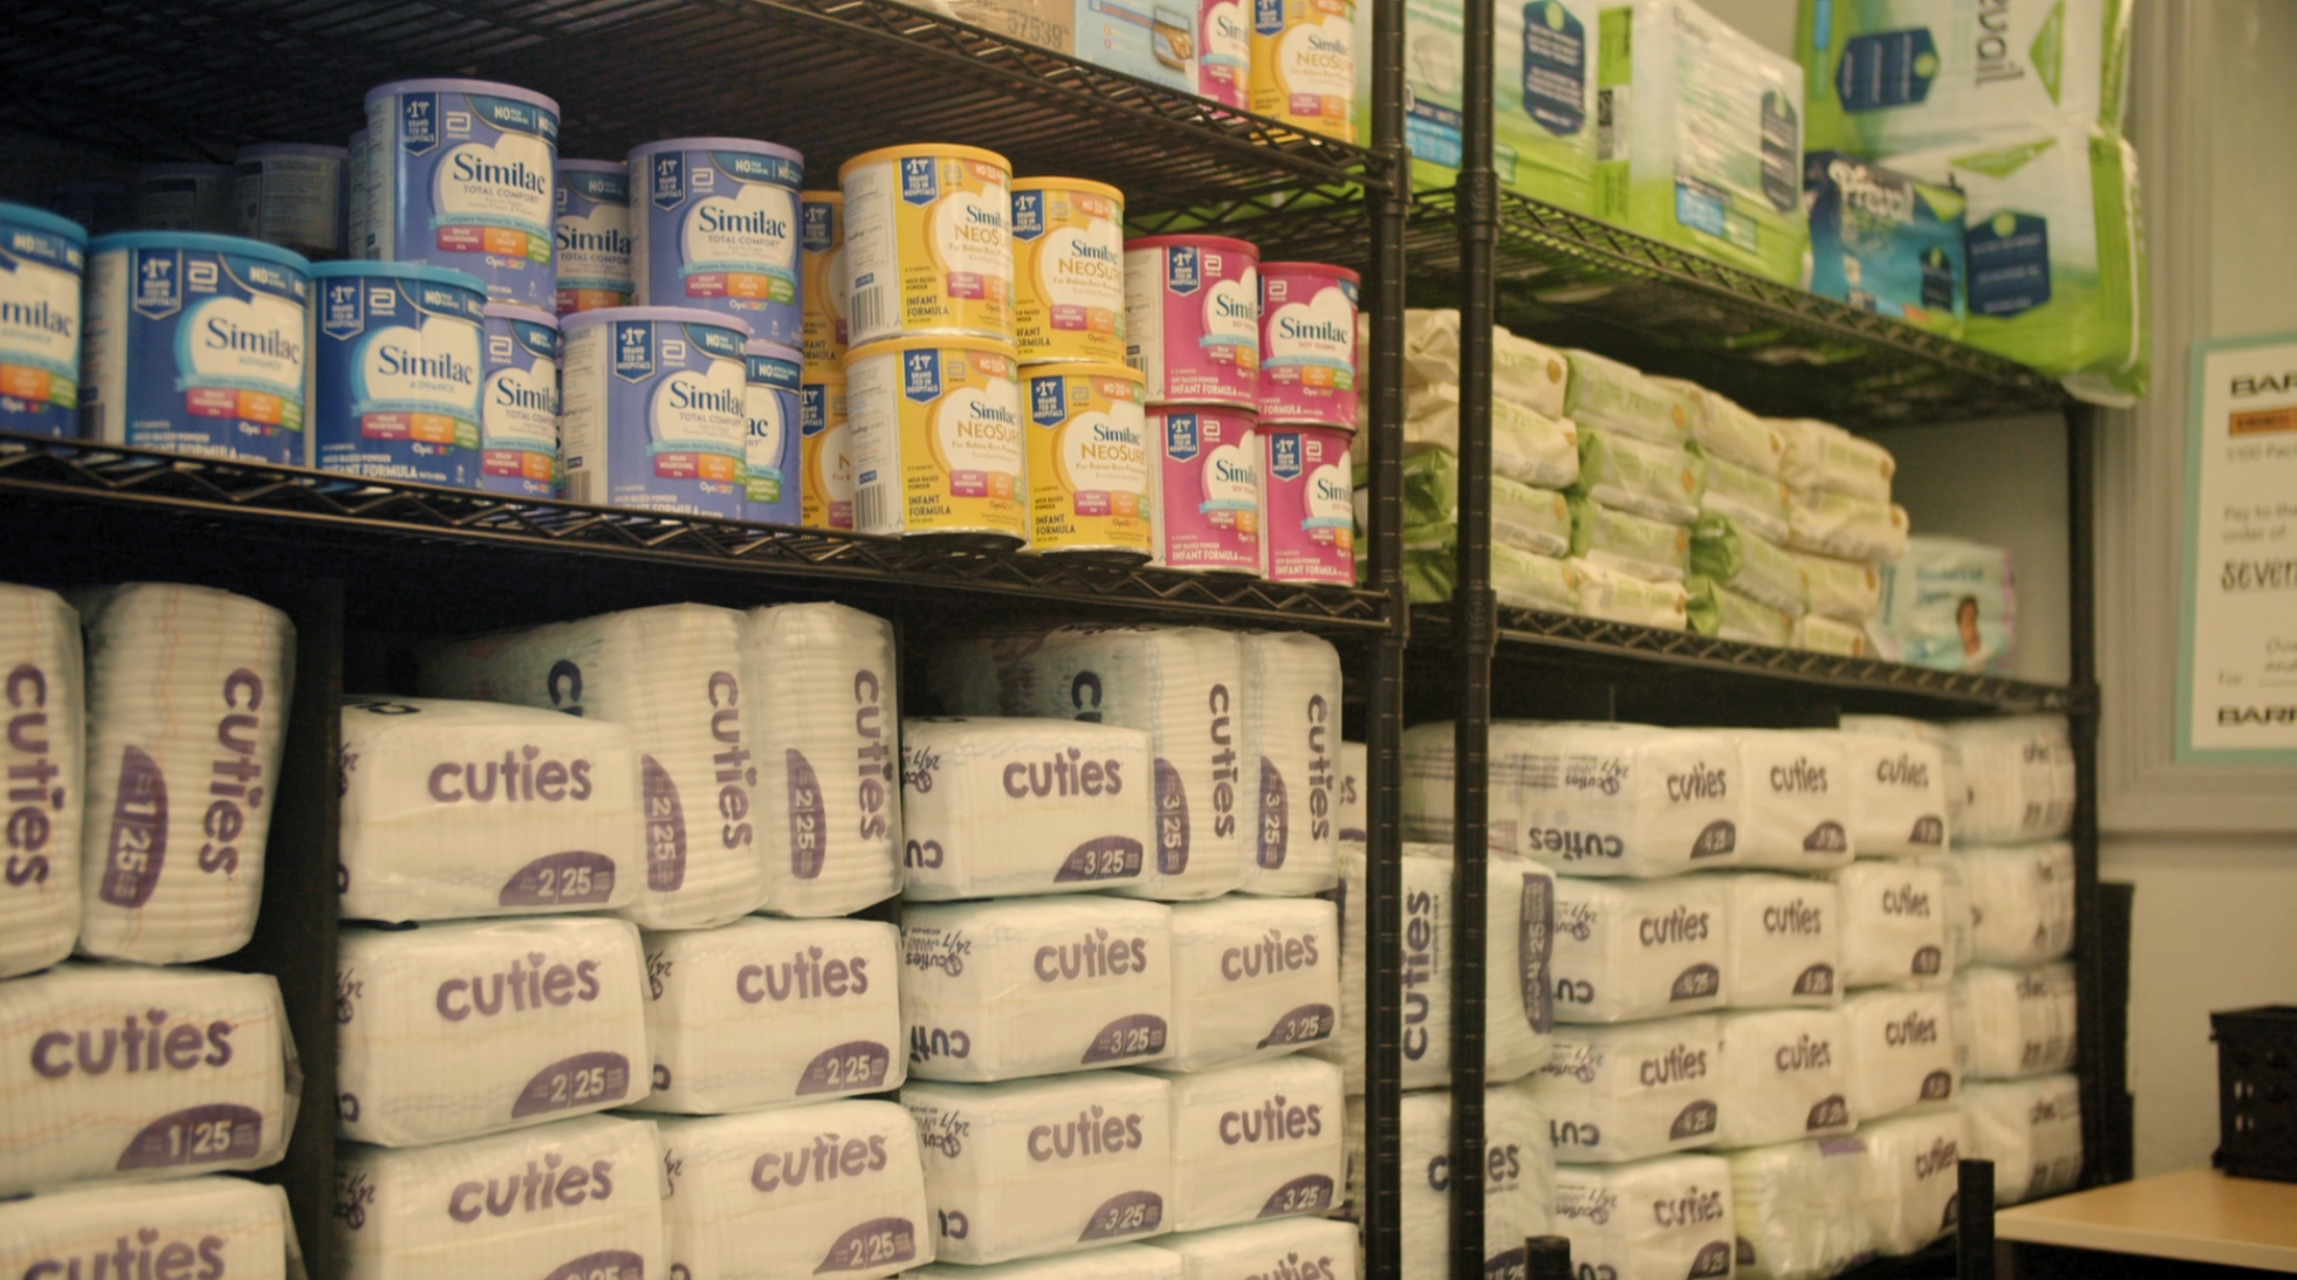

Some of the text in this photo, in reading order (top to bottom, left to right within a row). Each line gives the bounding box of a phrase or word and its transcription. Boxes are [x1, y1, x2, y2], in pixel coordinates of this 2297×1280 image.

[1006, 9, 1064, 50] 57539
[408, 118, 429, 128] BRAND
[494, 105, 510, 120] NO
[404, 134, 435, 144] HOSPITALS
[453, 152, 546, 195] Similac
[735, 160, 751, 173] NO
[908, 174, 929, 183] BRAND
[463, 184, 539, 203] TOTAL COMFORT
[904, 187, 935, 197] HOSPITALS
[699, 205, 787, 239] Similac
[556, 223, 631, 257] Simila
[708, 235, 779, 248] TOTAL COMFORT
[560, 252, 587, 262] TOTAL
[425, 290, 442, 304] NO
[906, 295, 938, 306] INFANT
[907, 305, 949, 317] FORMULA
[1, 301, 73, 338] milac
[1279, 316, 1348, 344] Similac
[205, 316, 301, 365] Similac
[529, 330, 541, 343] NO
[622, 346, 645, 355] BRAND
[705, 334, 720, 348] NO
[378, 344, 473, 386] Similac
[617, 361, 651, 370] HOSPITALS
[623, 354, 644, 362] FED IN
[758, 363, 773, 377] NO
[410, 379, 455, 394] ADVANCE
[906, 385, 938, 394] HOSPITALS
[911, 371, 932, 380] BRAND
[911, 378, 932, 386] FED IN
[1171, 384, 1237, 396] INFANT FORMULA
[669, 380, 745, 416] Similac
[969, 400, 1016, 424] Similac
[1037, 398, 1057, 406] BRAND
[1264, 404, 1302, 415] FORMULA
[679, 411, 707, 422] TOTAL
[1033, 410, 1063, 419] HOSPITALS
[1093, 422, 1141, 447] Similac
[908, 494, 940, 506] INFANT
[909, 505, 952, 517] FORMULA
[1035, 515, 1065, 526] INFANT
[1035, 524, 1076, 536] FORMULA
[1172, 550, 1238, 561] INFANT FORMULA
[1275, 565, 1338, 577] INFANT FORMULA
[707, 670, 758, 850] cuties
[854, 669, 894, 841] cuties
[1209, 683, 1238, 839] cuties
[1307, 693, 1334, 841] cuties
[5, 662, 66, 887] cuties
[198, 667, 264, 876] cuties
[427, 743, 593, 803] cuties
[1002, 746, 1123, 799] cuties
[1667, 761, 1727, 802] cuties
[1769, 755, 1829, 795] cuties
[651, 797, 678, 861] 2 25
[795, 789, 817, 851] 2 25
[1163, 794, 1182, 849] 3 25
[1265, 793, 1281, 845] 3 25
[116, 799, 157, 875] 1 25
[1528, 827, 1624, 862] cuties
[1084, 849, 1125, 875] 3 25
[537, 866, 592, 898] 2 25
[1639, 904, 1710, 947] cuties
[1762, 898, 1822, 936] cuties
[941, 929, 972, 955] 24/7
[1033, 927, 1148, 983] cuties
[1220, 928, 1320, 982] cuties
[436, 951, 601, 1022] cuties
[736, 944, 869, 1004] cuties
[1401, 890, 1430, 1061] cuties
[30, 1007, 235, 1079] cuties
[1110, 1027, 1150, 1054] 3 25
[1285, 1016, 1320, 1042] 3 25
[1885, 1010, 1938, 1048] cuties
[826, 1055, 871, 1086] 2 25
[1640, 1044, 1708, 1088] cuties
[550, 1067, 605, 1103] 2 25
[940, 1110, 972, 1138] 24/7
[1027, 1104, 1144, 1162] cuties
[1219, 1094, 1323, 1146] cuties
[168, 1120, 233, 1158] 1 25
[750, 1131, 889, 1193] cuties
[448, 1152, 614, 1224] cuties
[1284, 1186, 1319, 1213] 3 25
[1105, 1203, 1145, 1230] 3 25
[1653, 1184, 1724, 1228] cuties
[850, 1232, 896, 1267] 2 25
